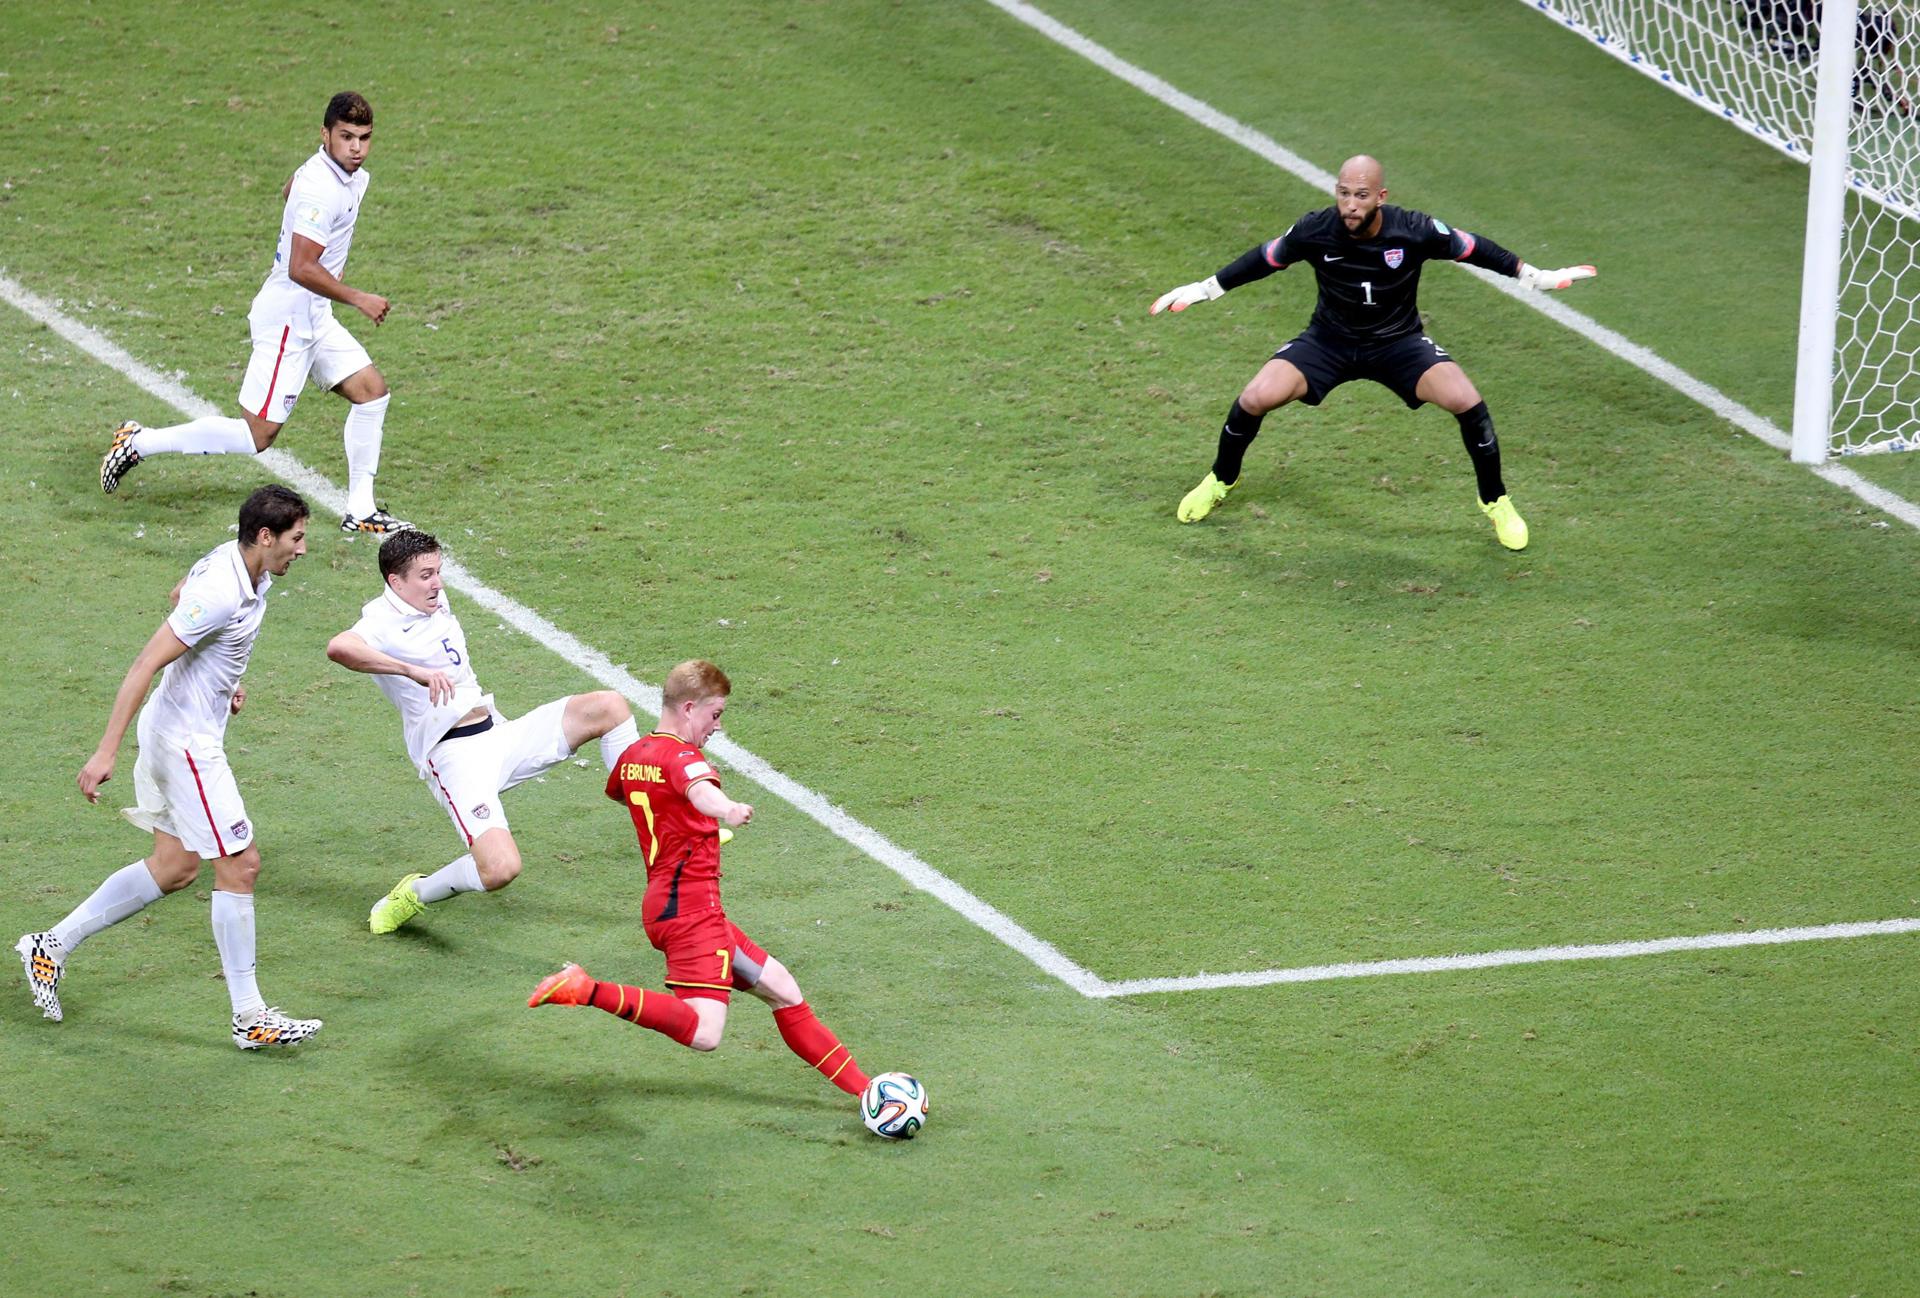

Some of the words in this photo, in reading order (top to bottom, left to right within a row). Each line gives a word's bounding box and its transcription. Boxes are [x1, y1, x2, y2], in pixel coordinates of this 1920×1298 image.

[1360, 281, 1377, 305] 1
[441, 637, 462, 666] 5
[629, 790, 659, 866] 7
[716, 949, 730, 980] 7
